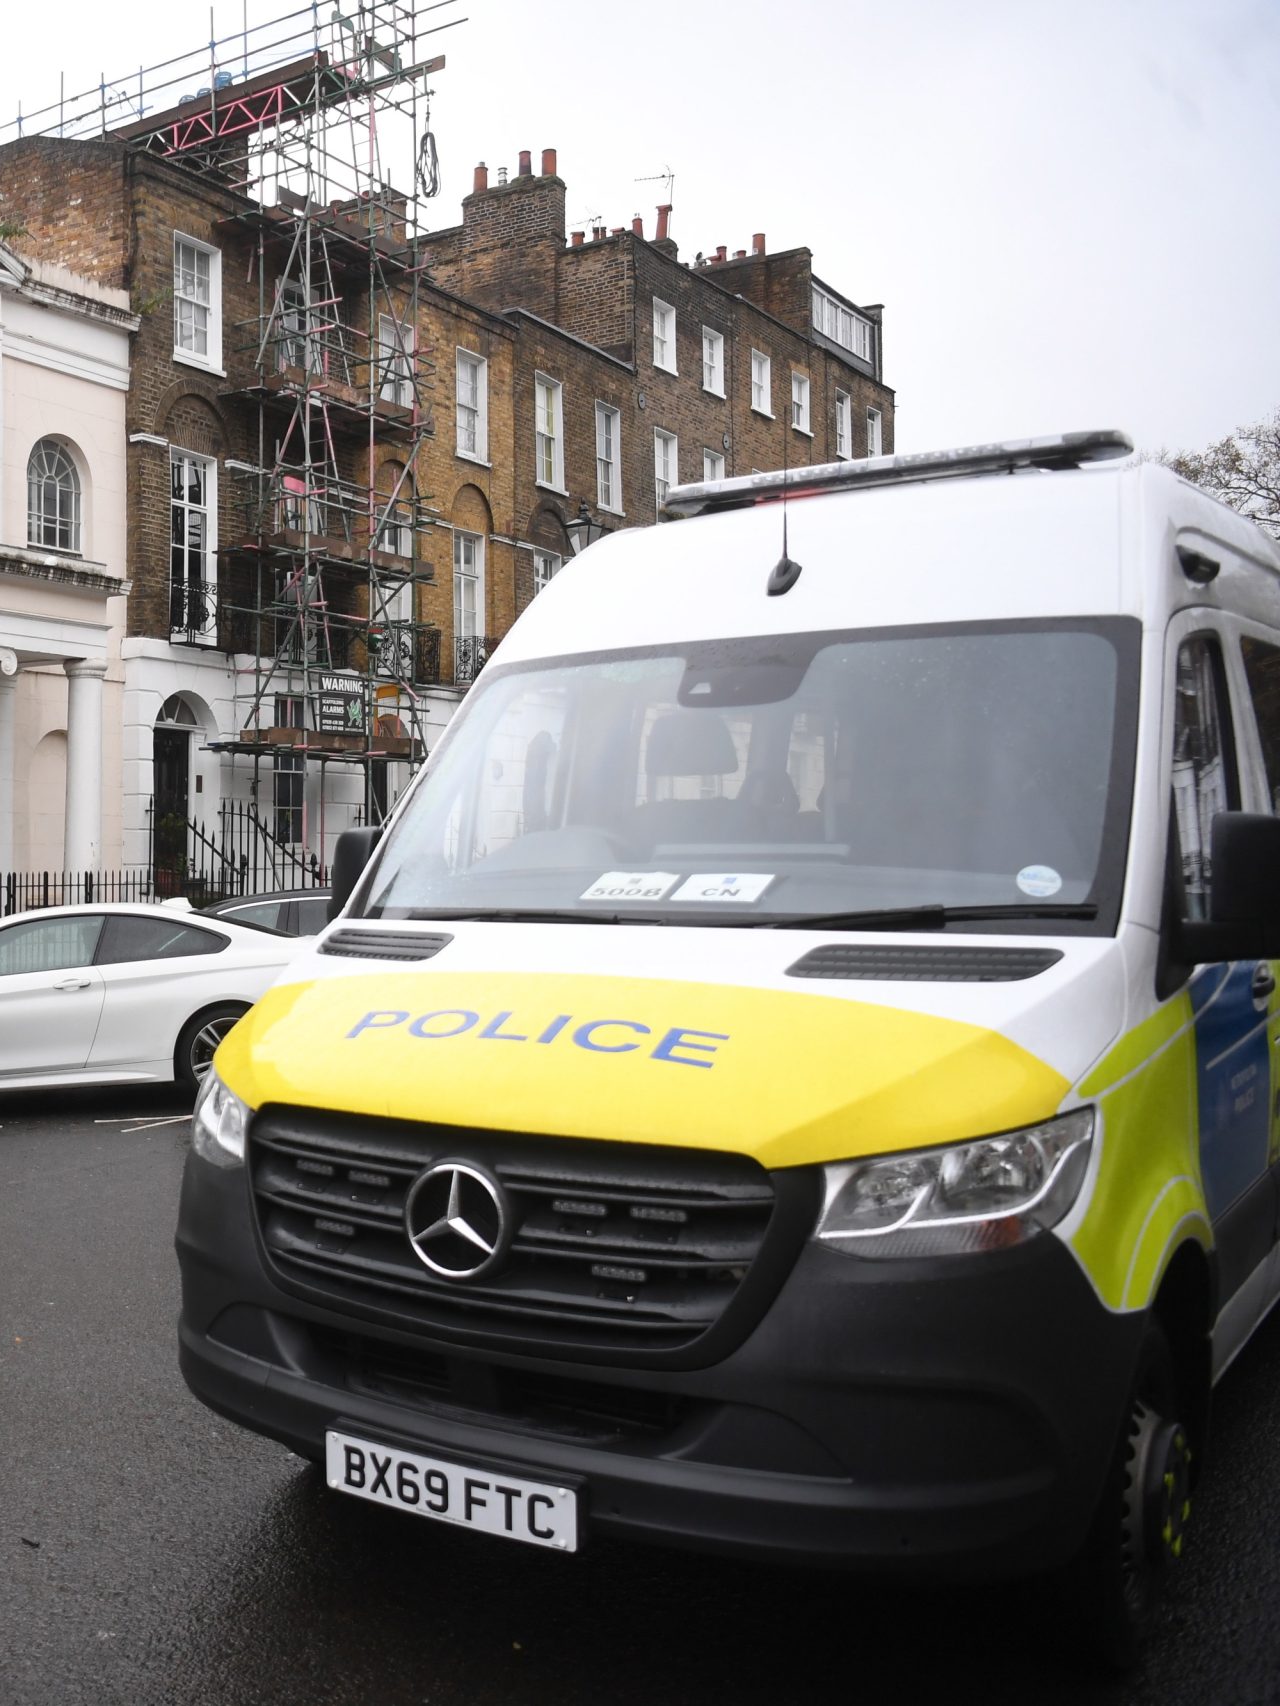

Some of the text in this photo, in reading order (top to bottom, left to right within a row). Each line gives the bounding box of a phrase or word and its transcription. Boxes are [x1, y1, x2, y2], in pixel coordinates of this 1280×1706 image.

[321, 677, 363, 694] WARNING
[321, 705, 345, 714] ALARMS
[590, 887, 663, 898] 500B
[700, 888, 742, 898] CN
[344, 1009, 731, 1069] POLICE
[343, 1444, 556, 1540] BX69 FTC
